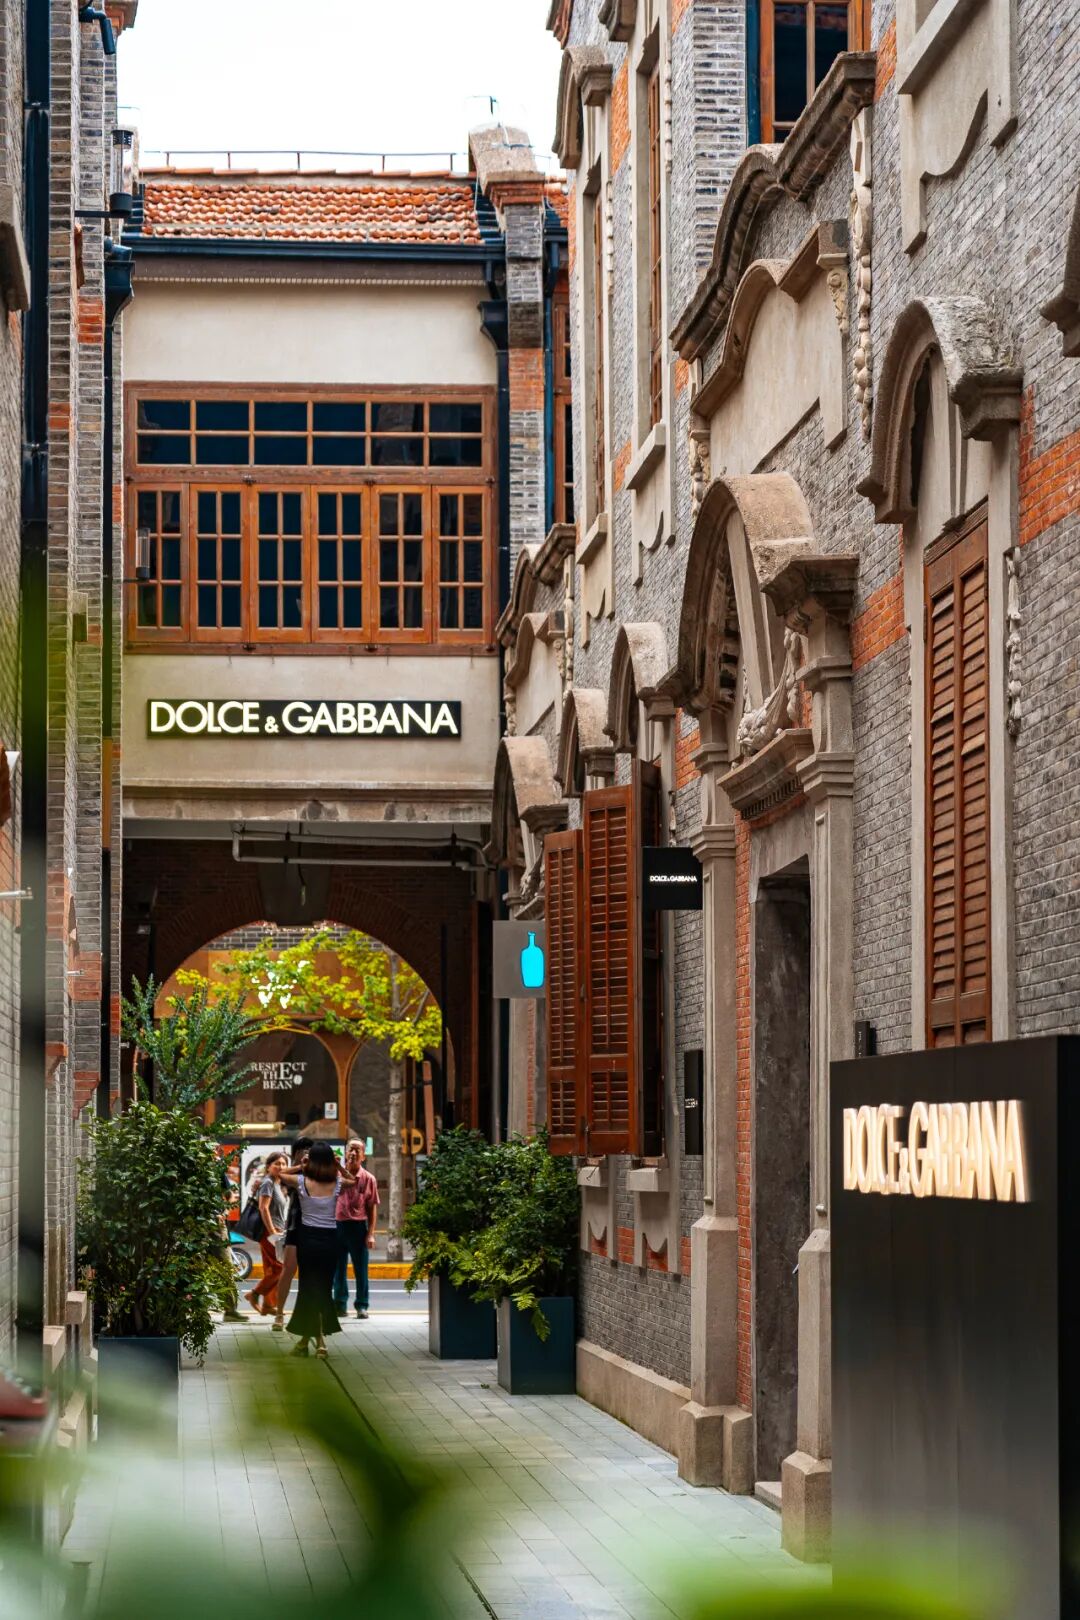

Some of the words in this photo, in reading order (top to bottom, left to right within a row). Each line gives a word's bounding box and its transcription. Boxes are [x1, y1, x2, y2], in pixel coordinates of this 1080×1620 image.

[150, 701, 259, 734] DOLCE
[264, 716, 280, 734] &
[282, 702, 458, 735] GABBANA
[251, 1062, 307, 1079] RESPECT
[262, 1080, 293, 1090] BEAN
